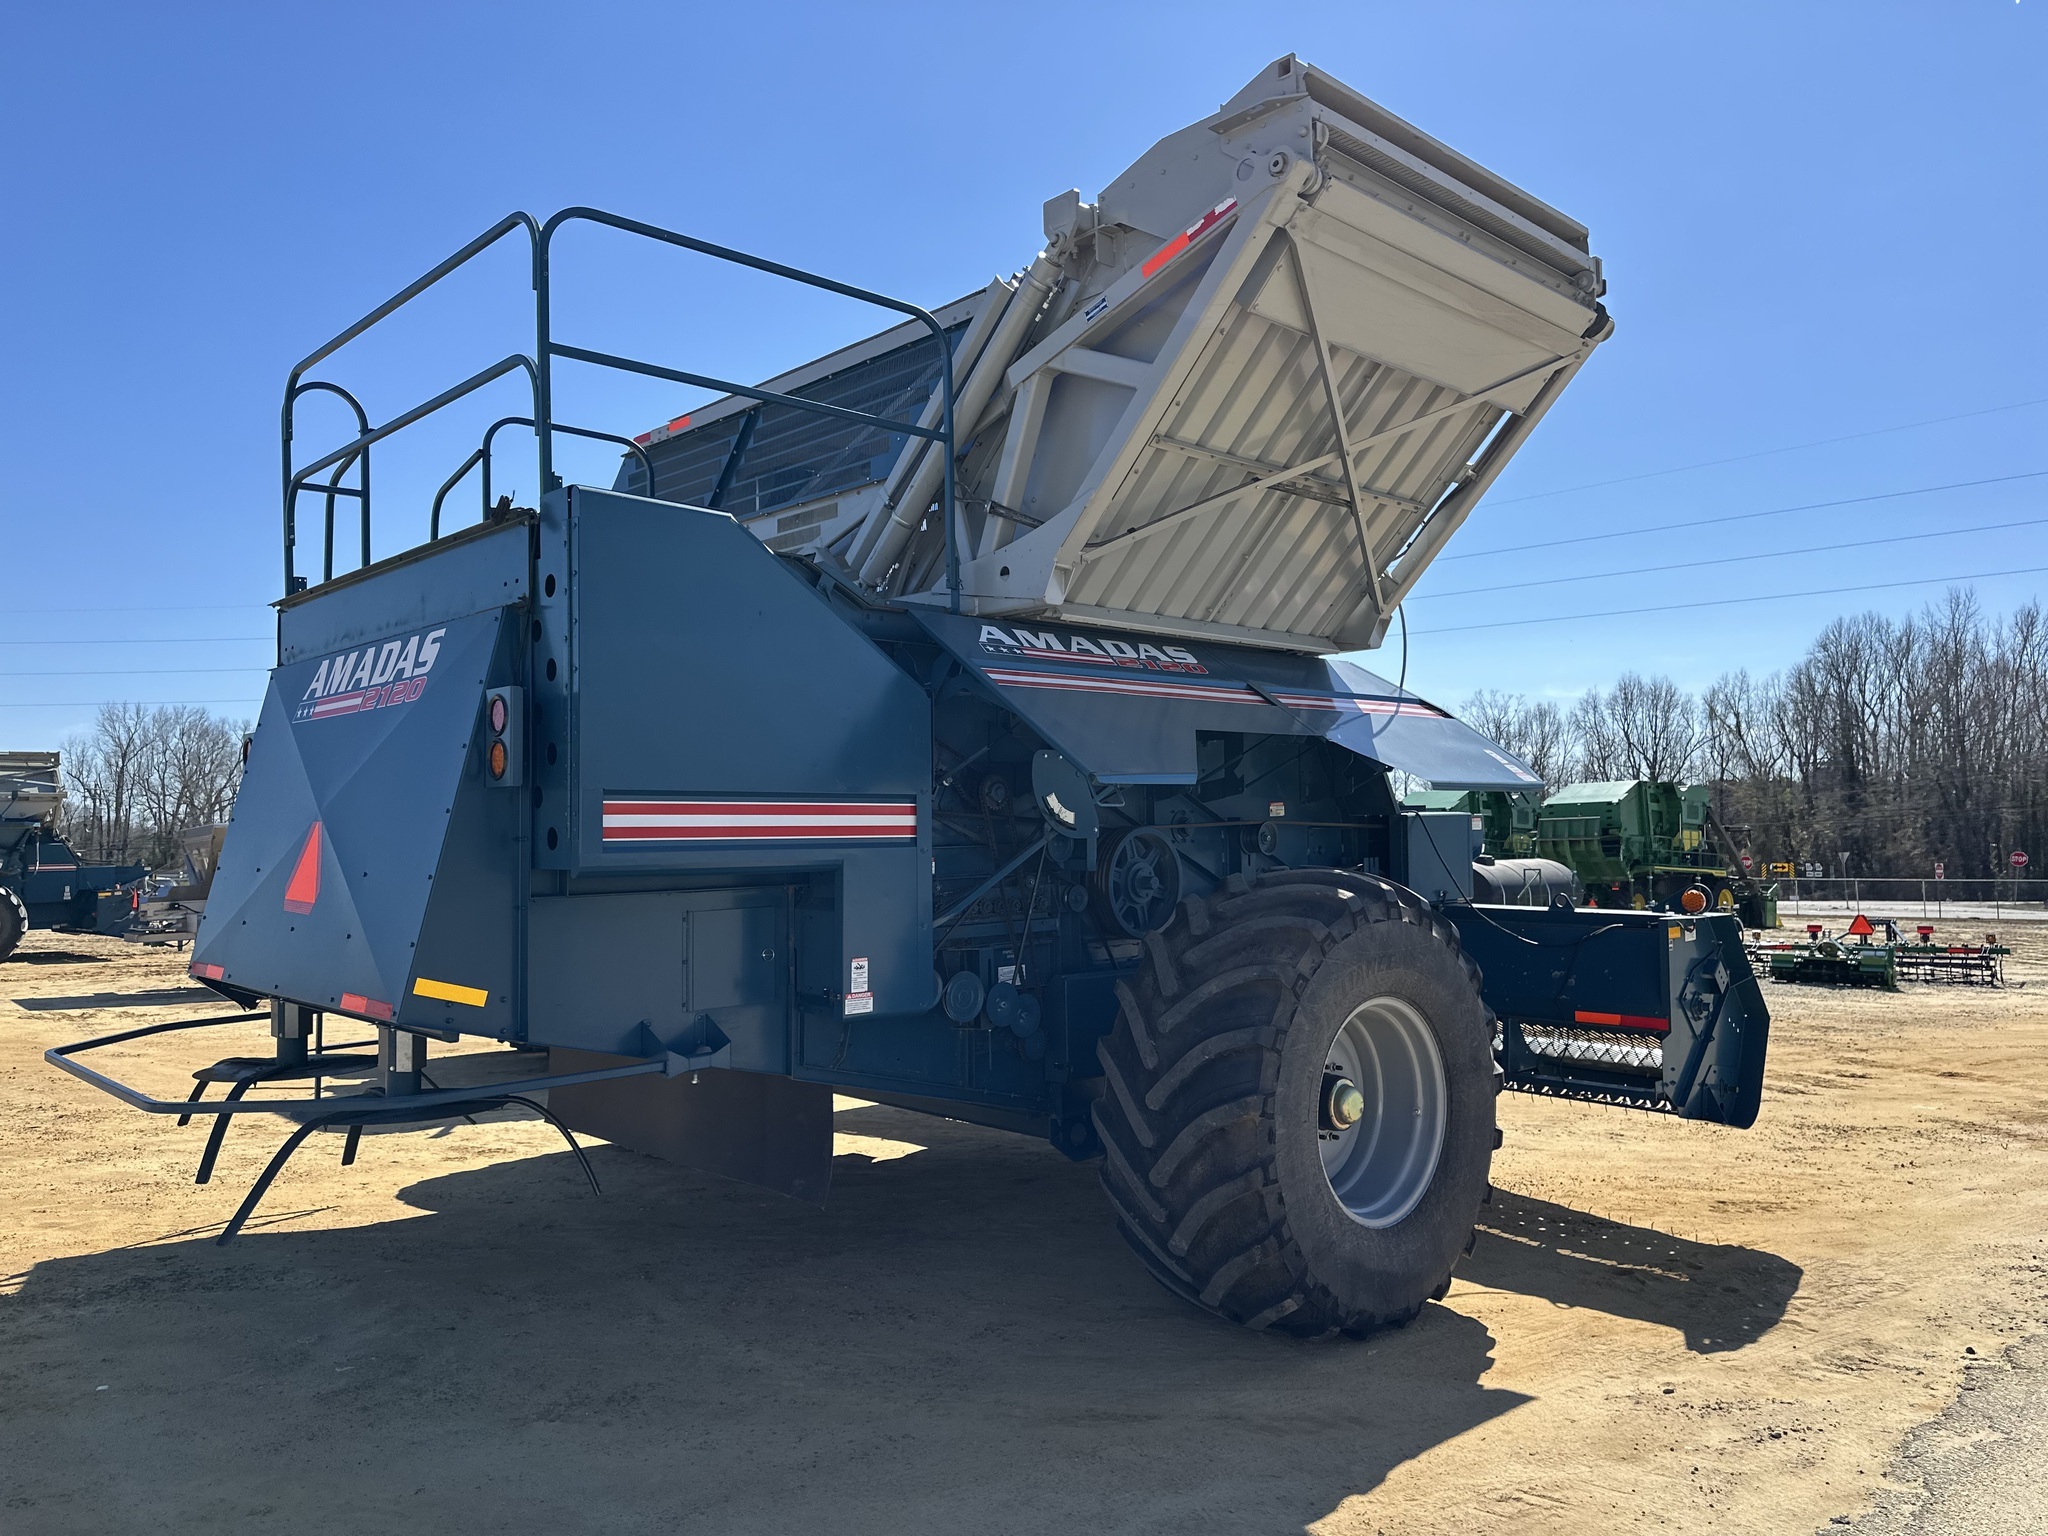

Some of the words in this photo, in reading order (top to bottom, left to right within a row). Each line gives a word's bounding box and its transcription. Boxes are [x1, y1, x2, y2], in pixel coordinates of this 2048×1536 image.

[979, 625, 1199, 664] AMADAS
[302, 628, 446, 700] AMADAS
[1114, 658, 1209, 674] 2120
[360, 676, 428, 712] 2120
